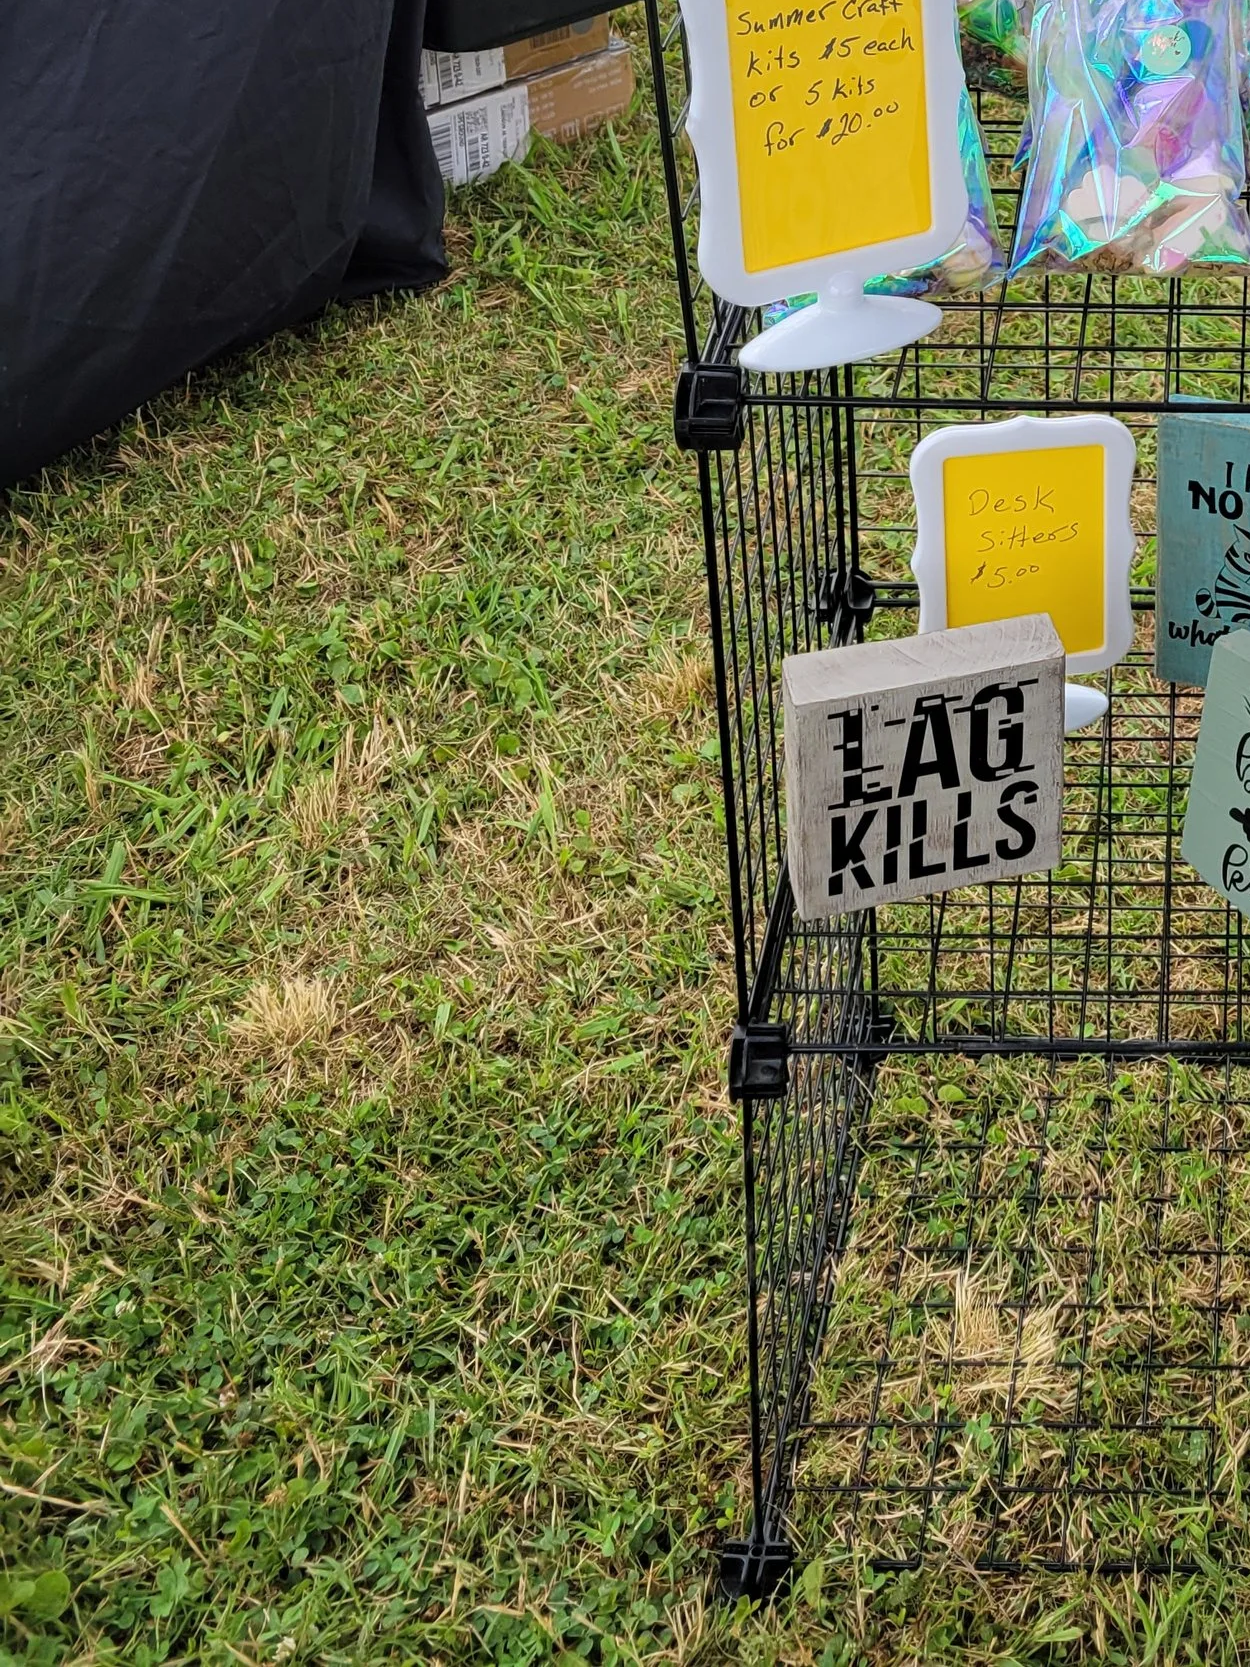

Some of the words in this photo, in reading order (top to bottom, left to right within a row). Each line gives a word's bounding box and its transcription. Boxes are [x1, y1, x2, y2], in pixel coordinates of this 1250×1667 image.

[737, 0, 836, 35] Summer
[819, 36, 861, 61] $5
[863, 28, 915, 54] each
[749, 85, 783, 108] or
[804, 80, 824, 105] 5
[764, 121, 805, 156] for
[1225, 461, 1234, 488] I
[1187, 479, 1244, 521] NO
[970, 561, 1040, 588] $5.00
[827, 677, 1039, 811] LAG
[827, 779, 1040, 897] KILLS
